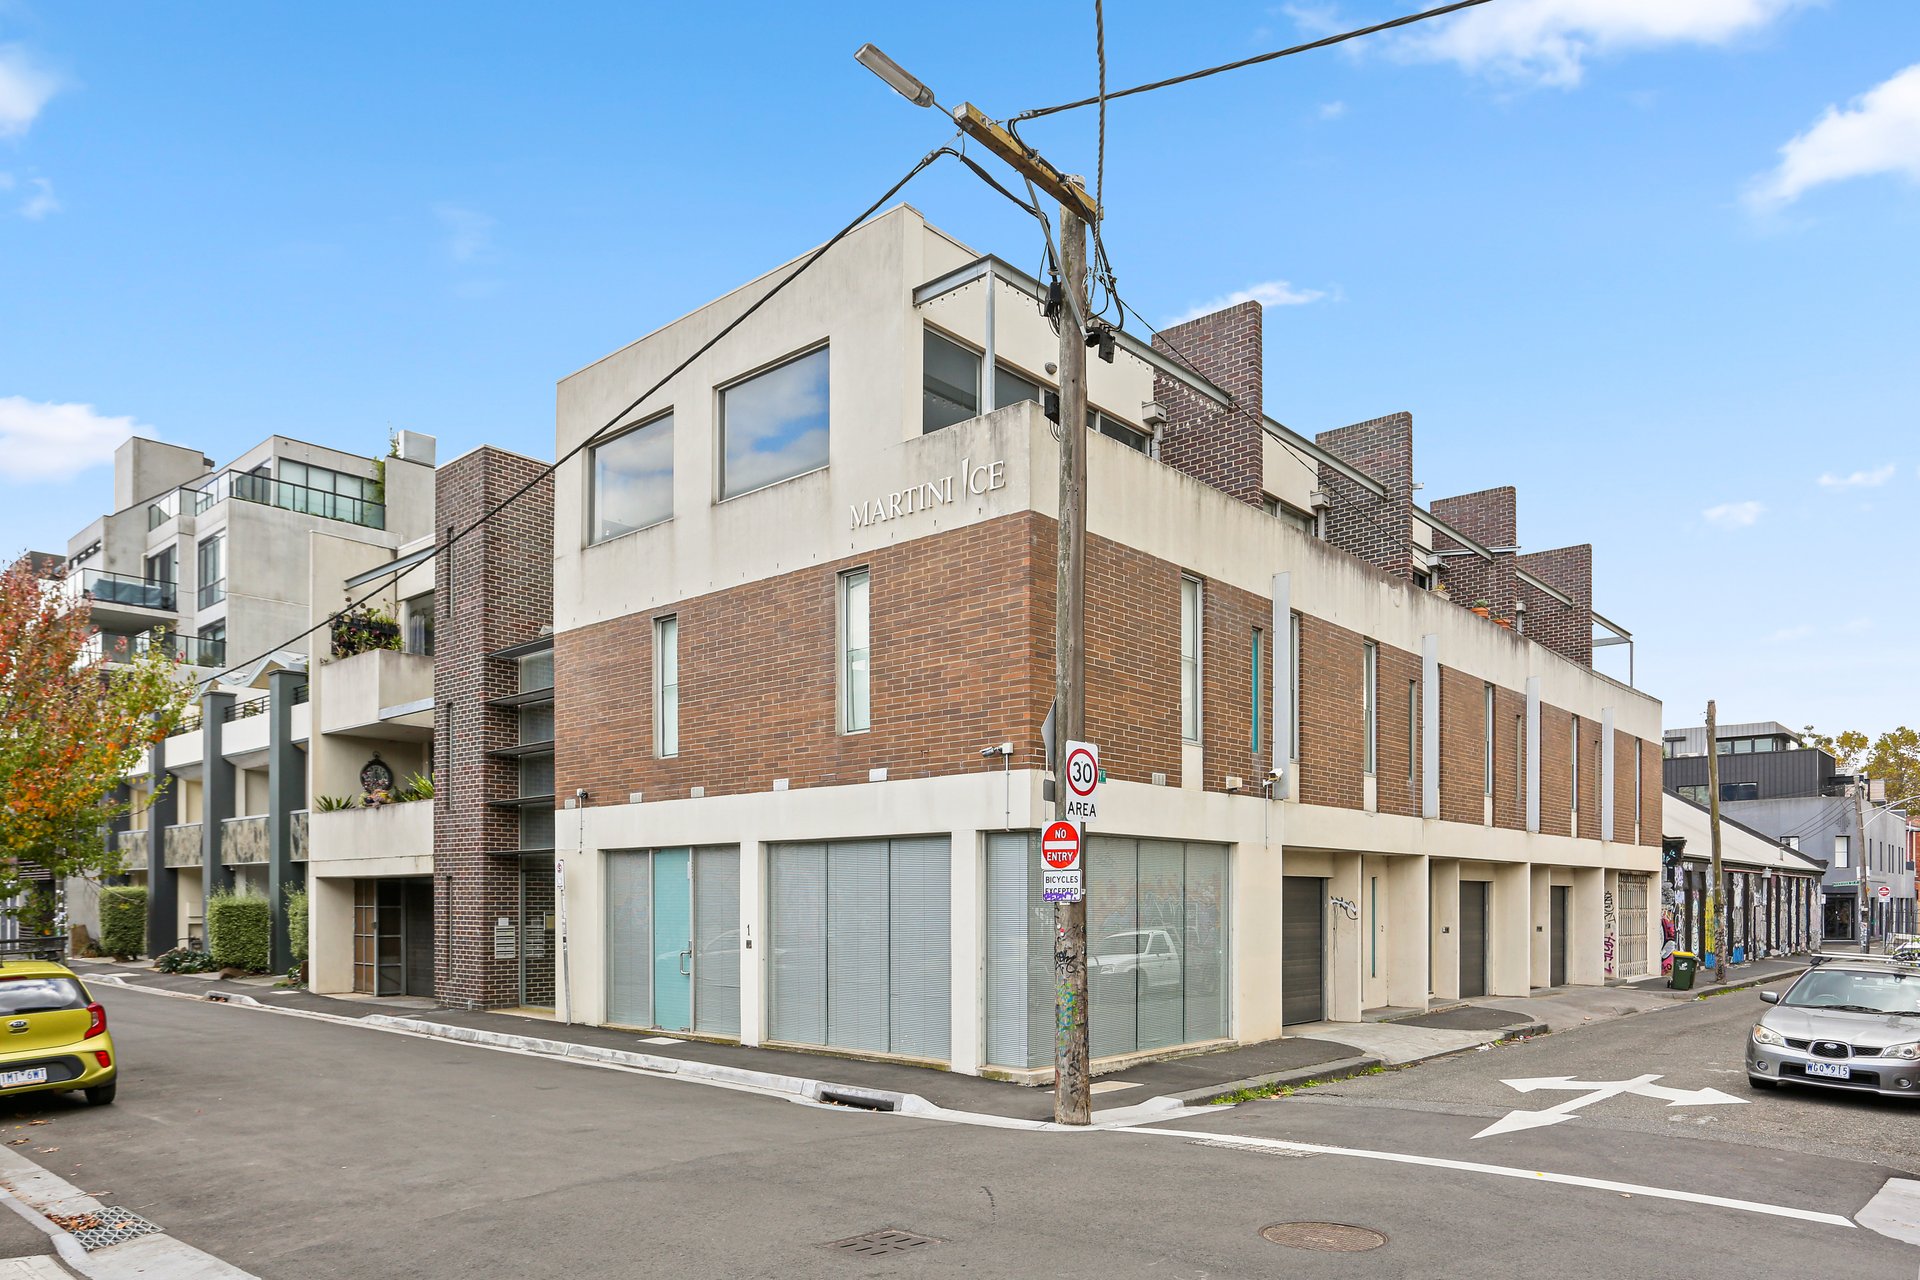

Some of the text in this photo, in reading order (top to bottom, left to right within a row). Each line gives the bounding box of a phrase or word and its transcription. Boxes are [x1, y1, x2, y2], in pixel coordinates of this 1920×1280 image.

[849, 457, 1006, 530] MARTINI ICE
[1072, 761, 1092, 784] 30
[1067, 801, 1097, 817] AREA
[1055, 829, 1067, 838] NO
[1046, 852, 1074, 861] ENTRY
[1045, 876, 1079, 884] BICYCLES
